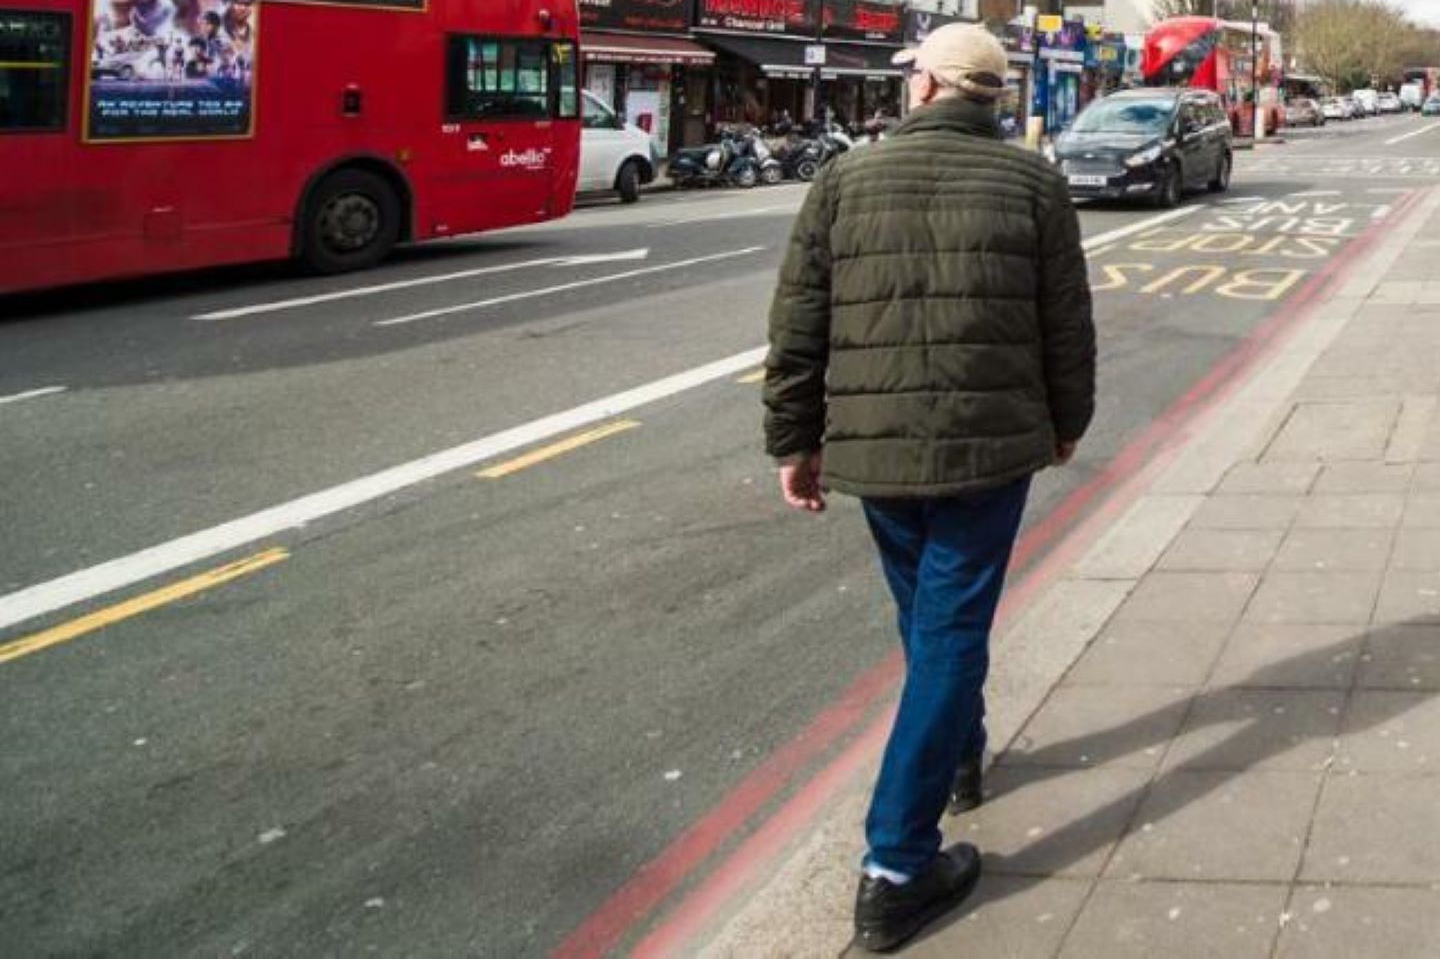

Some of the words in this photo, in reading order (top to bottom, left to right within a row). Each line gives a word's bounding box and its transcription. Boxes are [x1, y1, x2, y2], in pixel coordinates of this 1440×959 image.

[1202, 215, 1354, 234] BUS
[1129, 228, 1341, 259] STOP
[1092, 262, 1307, 300] BUS
